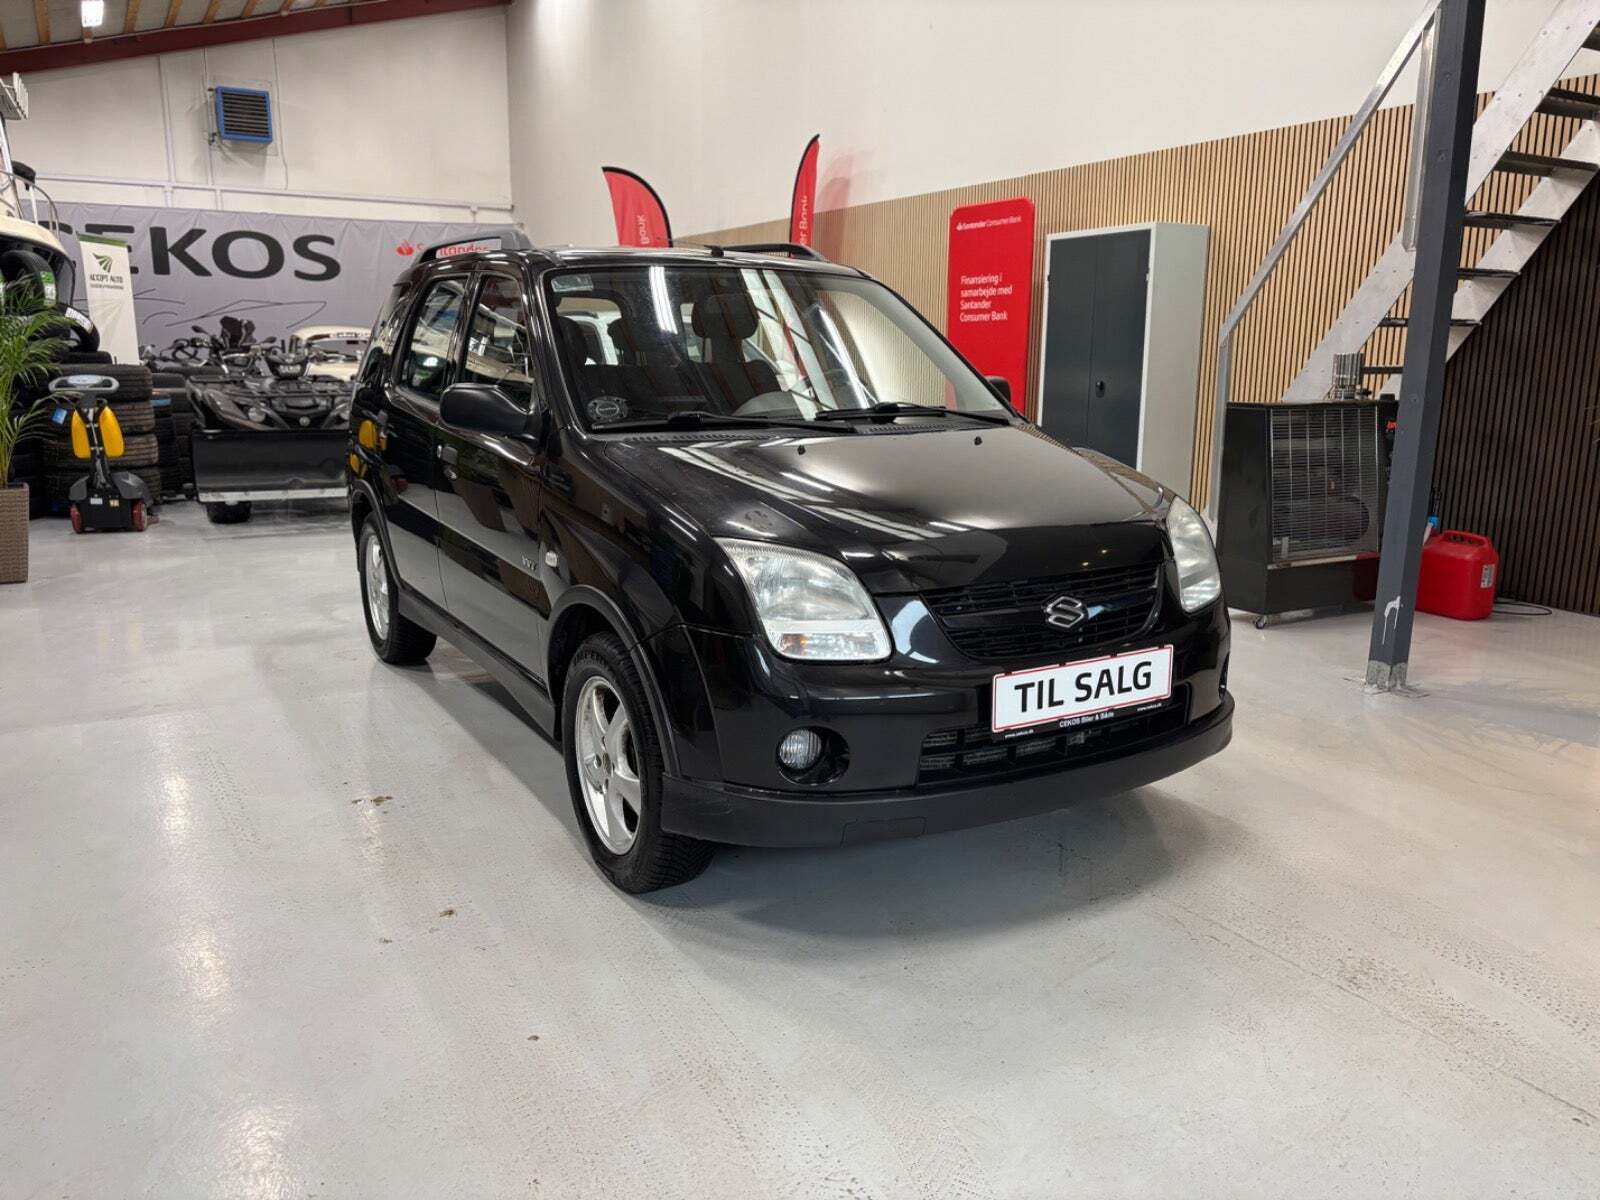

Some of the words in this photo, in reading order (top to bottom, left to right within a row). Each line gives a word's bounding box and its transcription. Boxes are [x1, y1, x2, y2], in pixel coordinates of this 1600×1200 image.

[961, 274, 998, 286] Finansiering
[961, 286, 997, 298] samarbejde
[997, 285, 1012, 296] med
[960, 300, 991, 310] Santander
[960, 312, 990, 322] Consumer
[991, 311, 1007, 321] Bank
[1014, 678, 1064, 713] TIL
[1075, 661, 1152, 702] SALG
[1060, 718, 1081, 728] CEKOS
